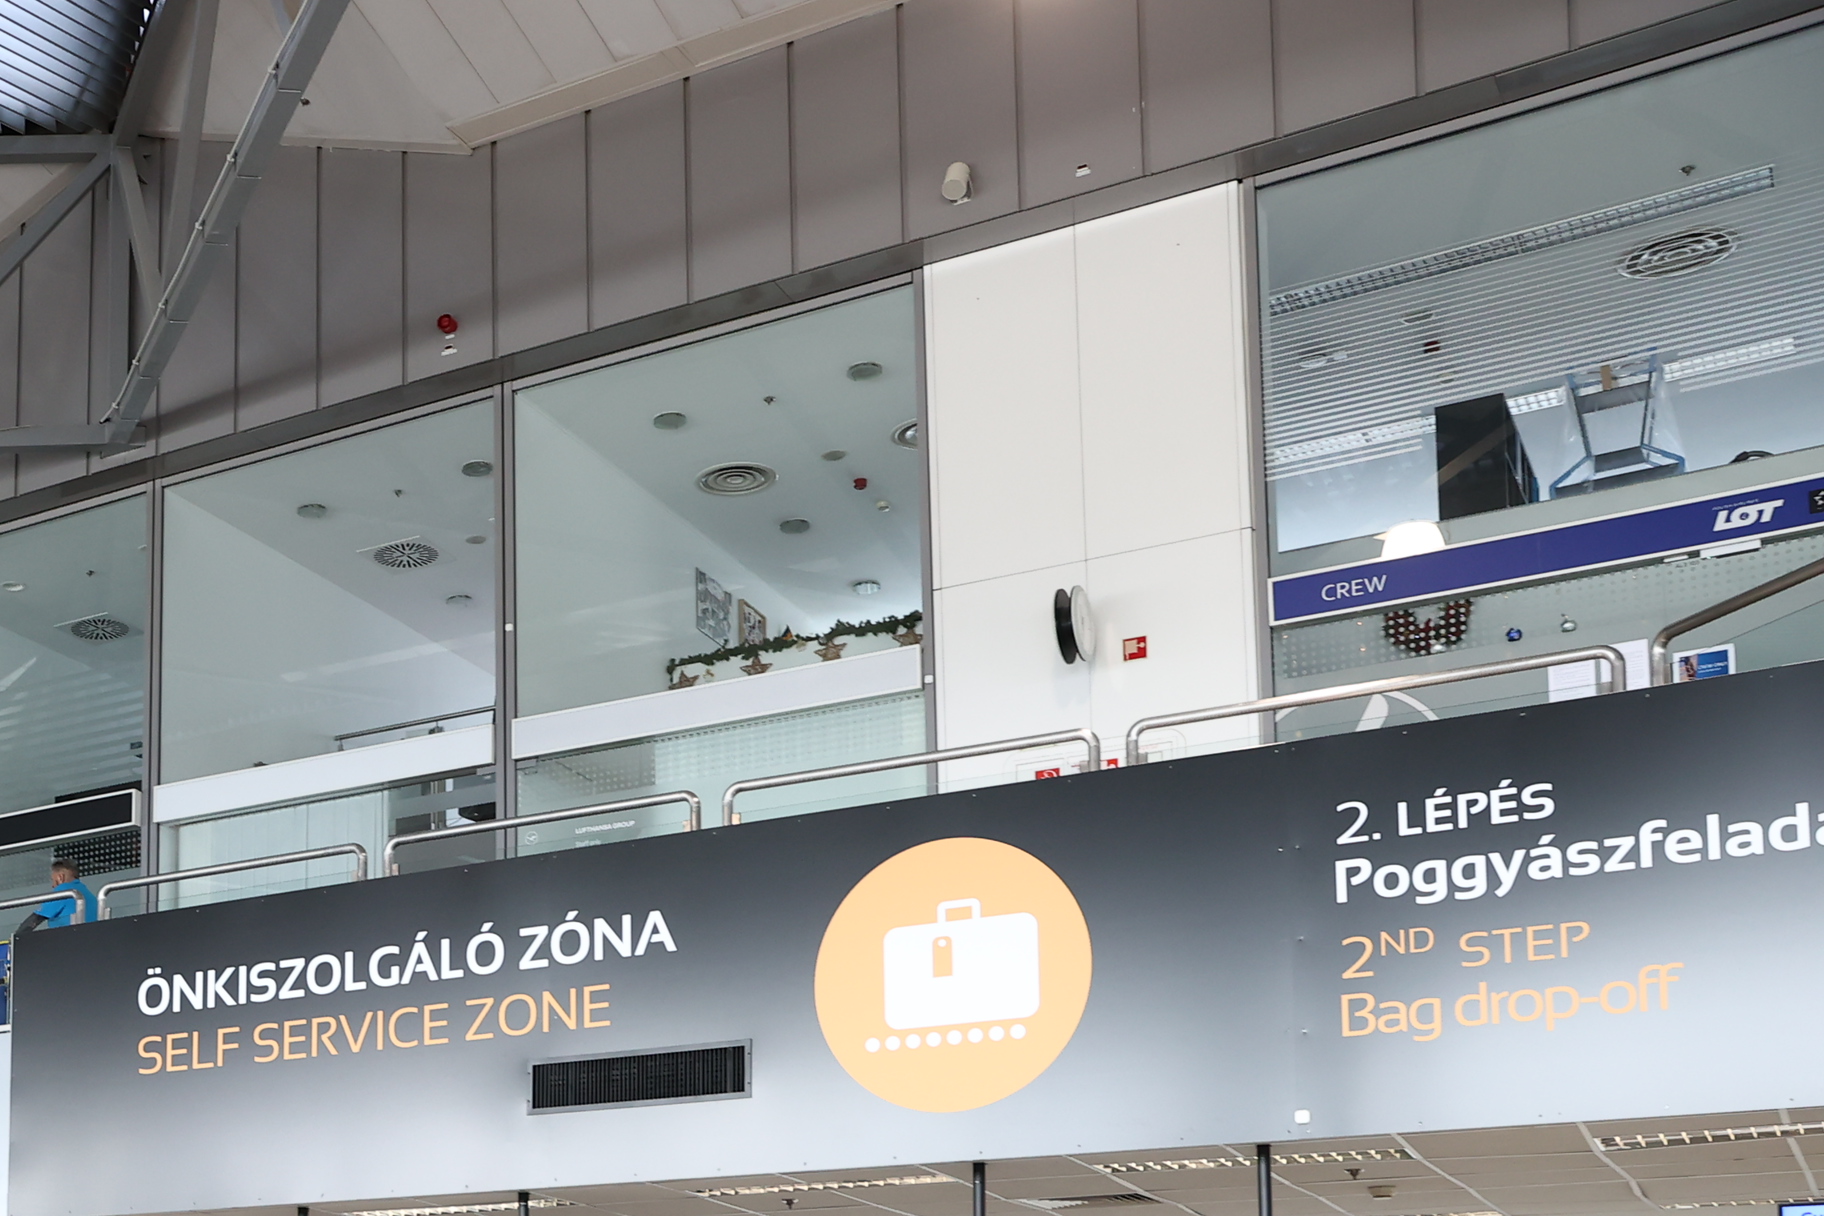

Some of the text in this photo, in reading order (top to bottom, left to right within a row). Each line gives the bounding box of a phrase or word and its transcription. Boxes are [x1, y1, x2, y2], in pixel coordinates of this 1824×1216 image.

[1713, 499, 1785, 531] LOT
[1321, 575, 1387, 602] CREW
[1335, 779, 1556, 845] 2. LÉPÉS
[1334, 802, 1824, 904] Poggyászfelad
[137, 910, 677, 1017] ÖNKISZOLGÁLÓ ZÓNA
[1459, 920, 1591, 968] STEP
[137, 984, 612, 1075] SELF SERVICE ZONE
[1340, 962, 1684, 1042] Bag drop-off
